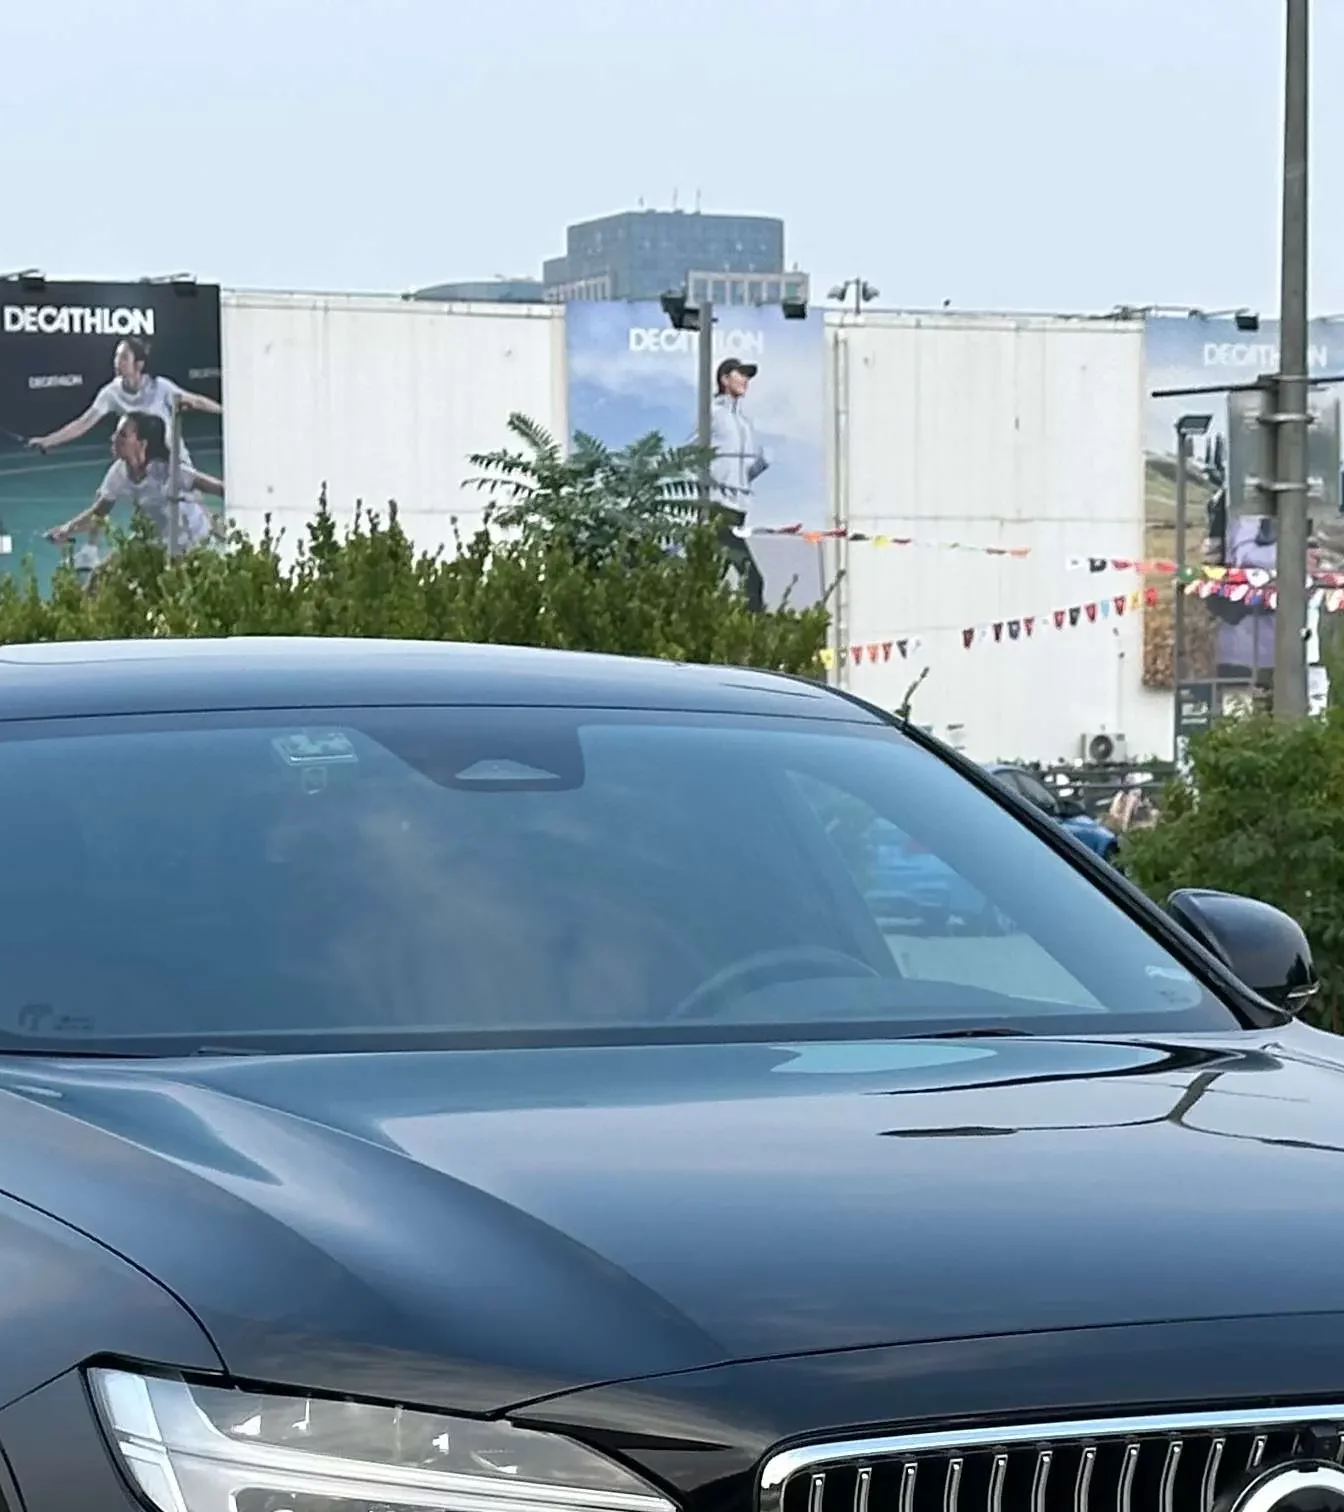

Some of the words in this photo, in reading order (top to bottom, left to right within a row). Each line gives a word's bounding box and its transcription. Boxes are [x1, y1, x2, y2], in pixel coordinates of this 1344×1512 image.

[2, 305, 155, 336] DECATHLON
[628, 327, 764, 355] DECATLON
[1203, 342, 1328, 368] DECATHN
